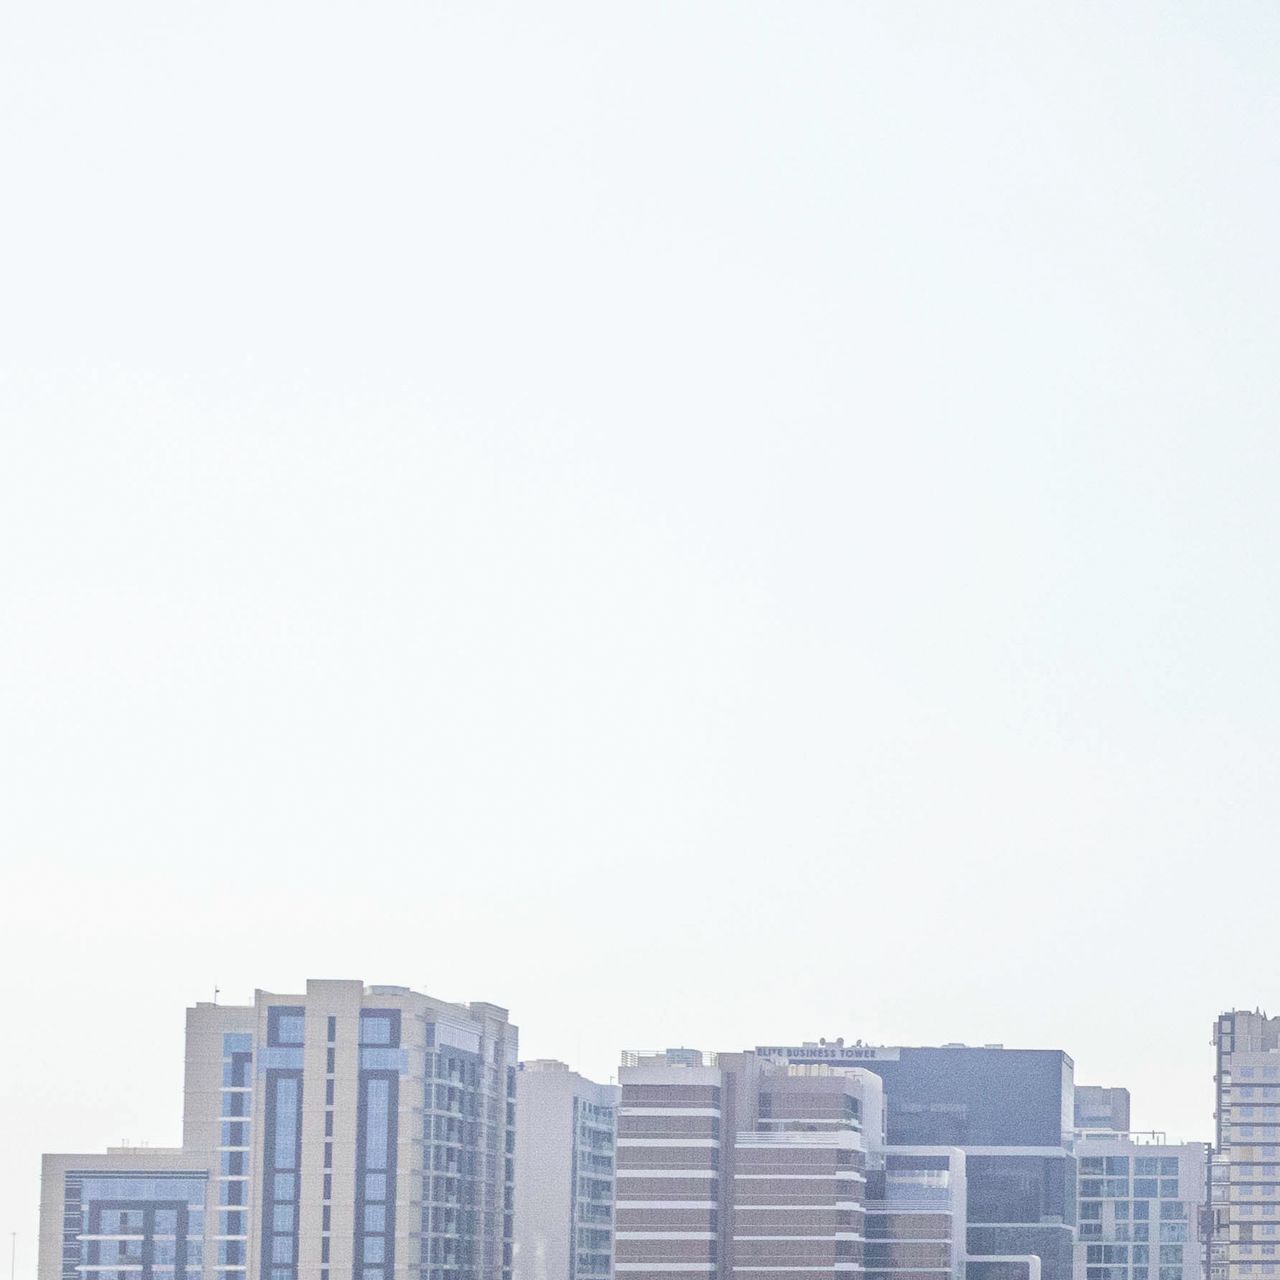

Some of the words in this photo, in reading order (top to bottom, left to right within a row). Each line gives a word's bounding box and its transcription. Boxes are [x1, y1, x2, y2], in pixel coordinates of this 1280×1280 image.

[757, 1047, 783, 1057] ELITE
[787, 1048, 836, 1058] BUSINESS
[840, 1049, 876, 1059] TOWER
